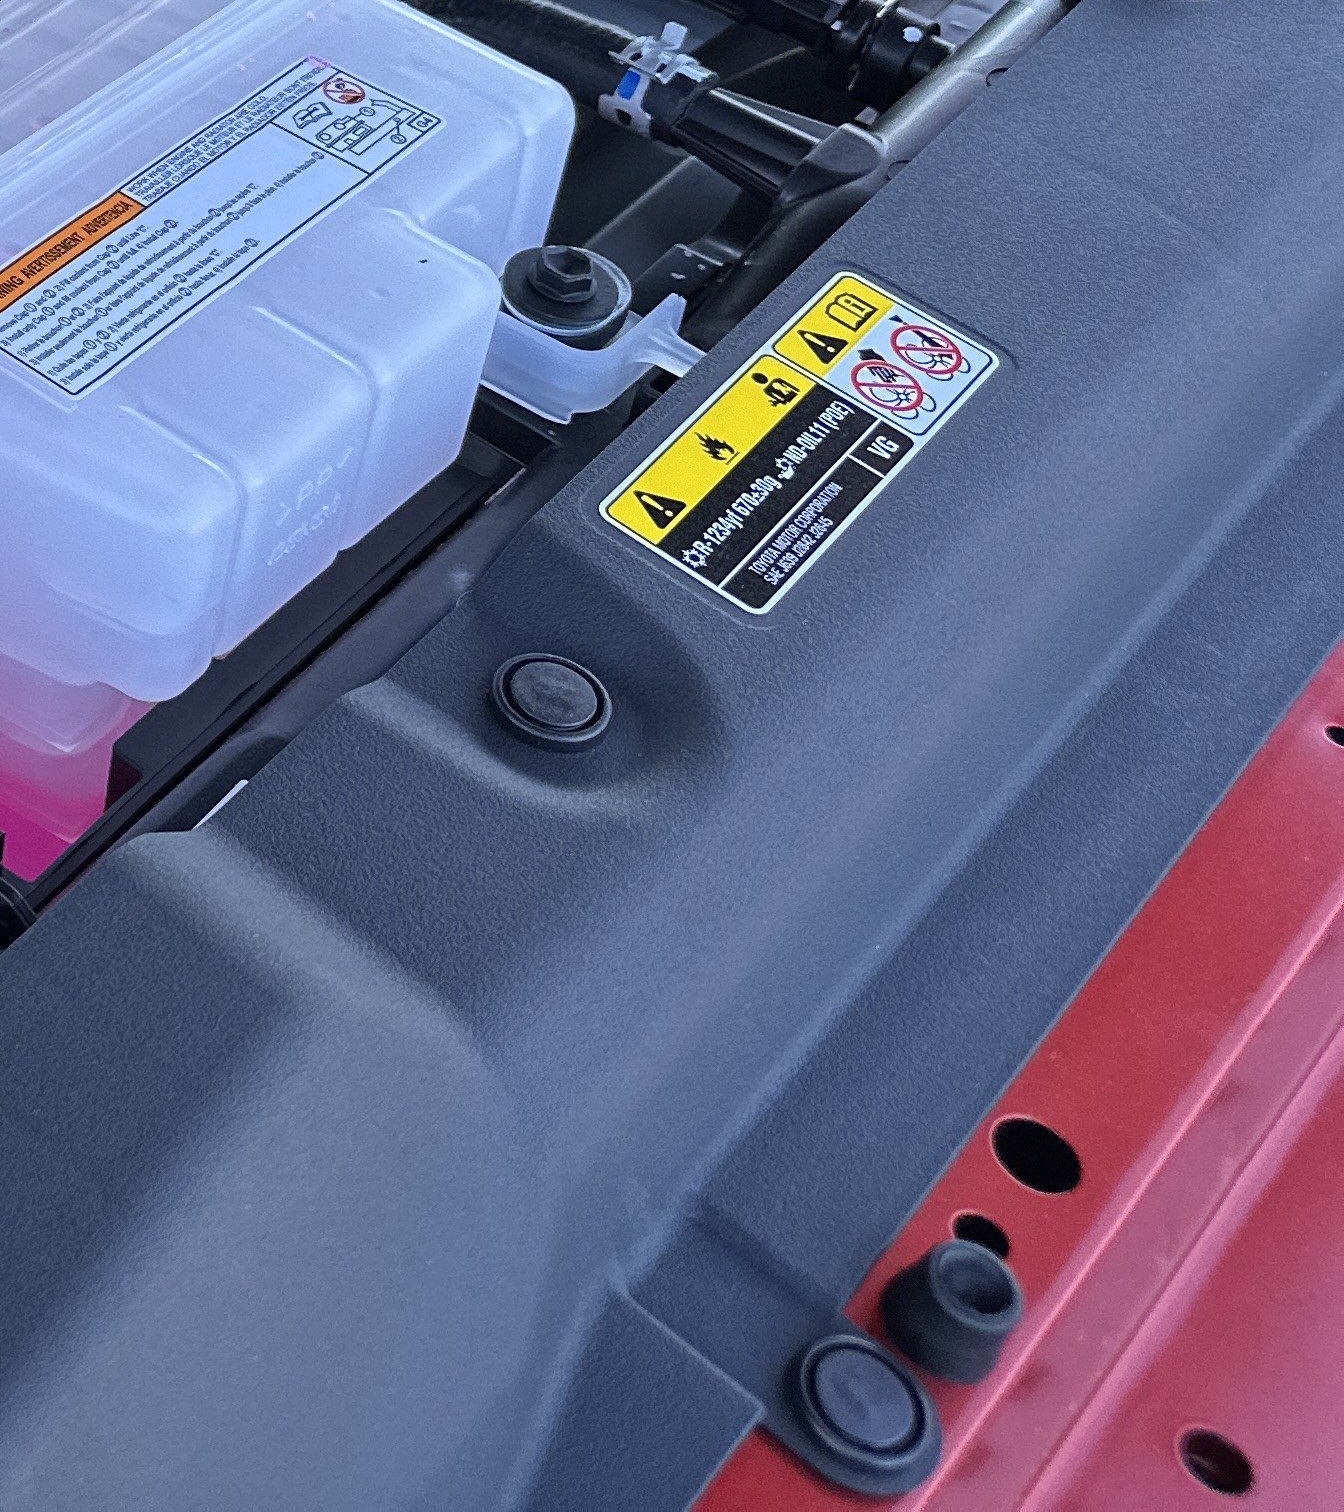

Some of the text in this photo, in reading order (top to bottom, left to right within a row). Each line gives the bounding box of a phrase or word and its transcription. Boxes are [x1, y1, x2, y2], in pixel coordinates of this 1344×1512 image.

[17, 231, 87, 279] AVERTISSEMENT
[79, 198, 133, 236] ADVERTENCIA
[694, 510, 748, 559] R-1234yf
[732, 473, 783, 519] 670±30g
[817, 400, 855, 431] (POE)
[866, 434, 900, 461] VG
[748, 481, 843, 576] TOYOTA MOTOR CORPORATION
[762, 566, 786, 586] SAE
